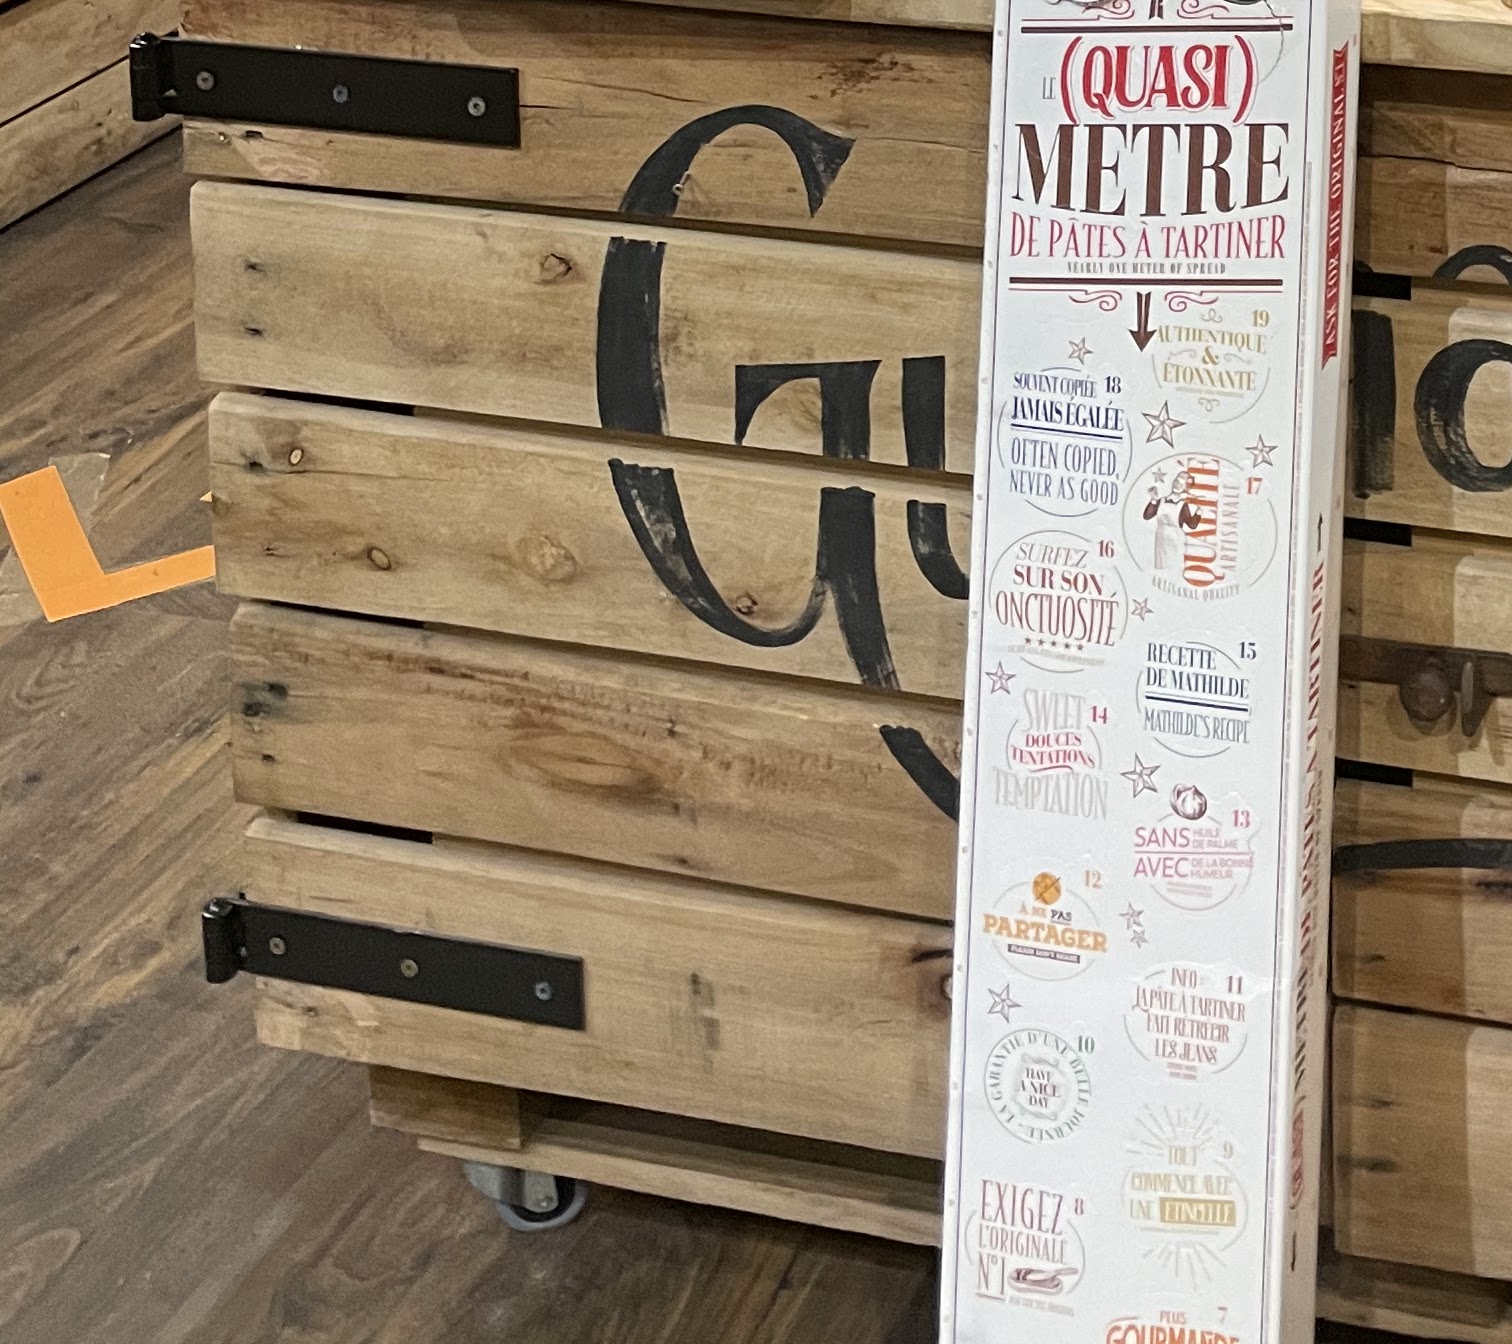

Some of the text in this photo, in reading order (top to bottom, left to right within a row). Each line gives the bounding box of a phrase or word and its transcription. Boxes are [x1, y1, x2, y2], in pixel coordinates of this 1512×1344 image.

[1043, 35, 1254, 125] LE (QUASI)
[1012, 123, 1290, 217] METRE
[1010, 212, 1286, 259] DE PÂTES À TARTINER
[1251, 310, 1270, 328] 19
[1157, 325, 1267, 355] AUTHENTIQUE
[1013, 371, 1097, 398] SOUVENT COPIÉE
[1104, 376, 1122, 395] 18
[1010, 396, 1125, 431] JAMAIS ÉGALÉE
[1011, 436, 1059, 470] OFTEN
[1010, 470, 1119, 506] NEVER AS GOOD
[1245, 477, 1263, 496] 17
[1016, 542, 1088, 570] SURFEZ
[1097, 540, 1115, 558] 16
[1013, 565, 1104, 595] SUR SON
[995, 590, 1119, 648] ONCTUOSITÉ
[1147, 642, 1217, 670] RECETTE
[1238, 641, 1257, 660] 15
[1146, 668, 1250, 700] DE MATHILDE
[1022, 688, 1086, 731] SWEET
[1092, 706, 1108, 724] 14
[1025, 733, 1082, 749] DOUCES
[1212, 715, 1250, 745] RECIPE
[1010, 745, 1096, 769] TENTATIONS
[993, 767, 1109, 821] TEMPTATION
[1232, 809, 1250, 828] 13
[1134, 827, 1190, 848] SANS
[1084, 870, 1102, 889] 12
[1133, 857, 1189, 878] AVEC
[983, 913, 1107, 952] PARTAGER
[1225, 975, 1243, 994] 11
[980, 1179, 1063, 1235] EXIGEZ
[978, 1224, 1068, 1264] L'ORIGINALE
